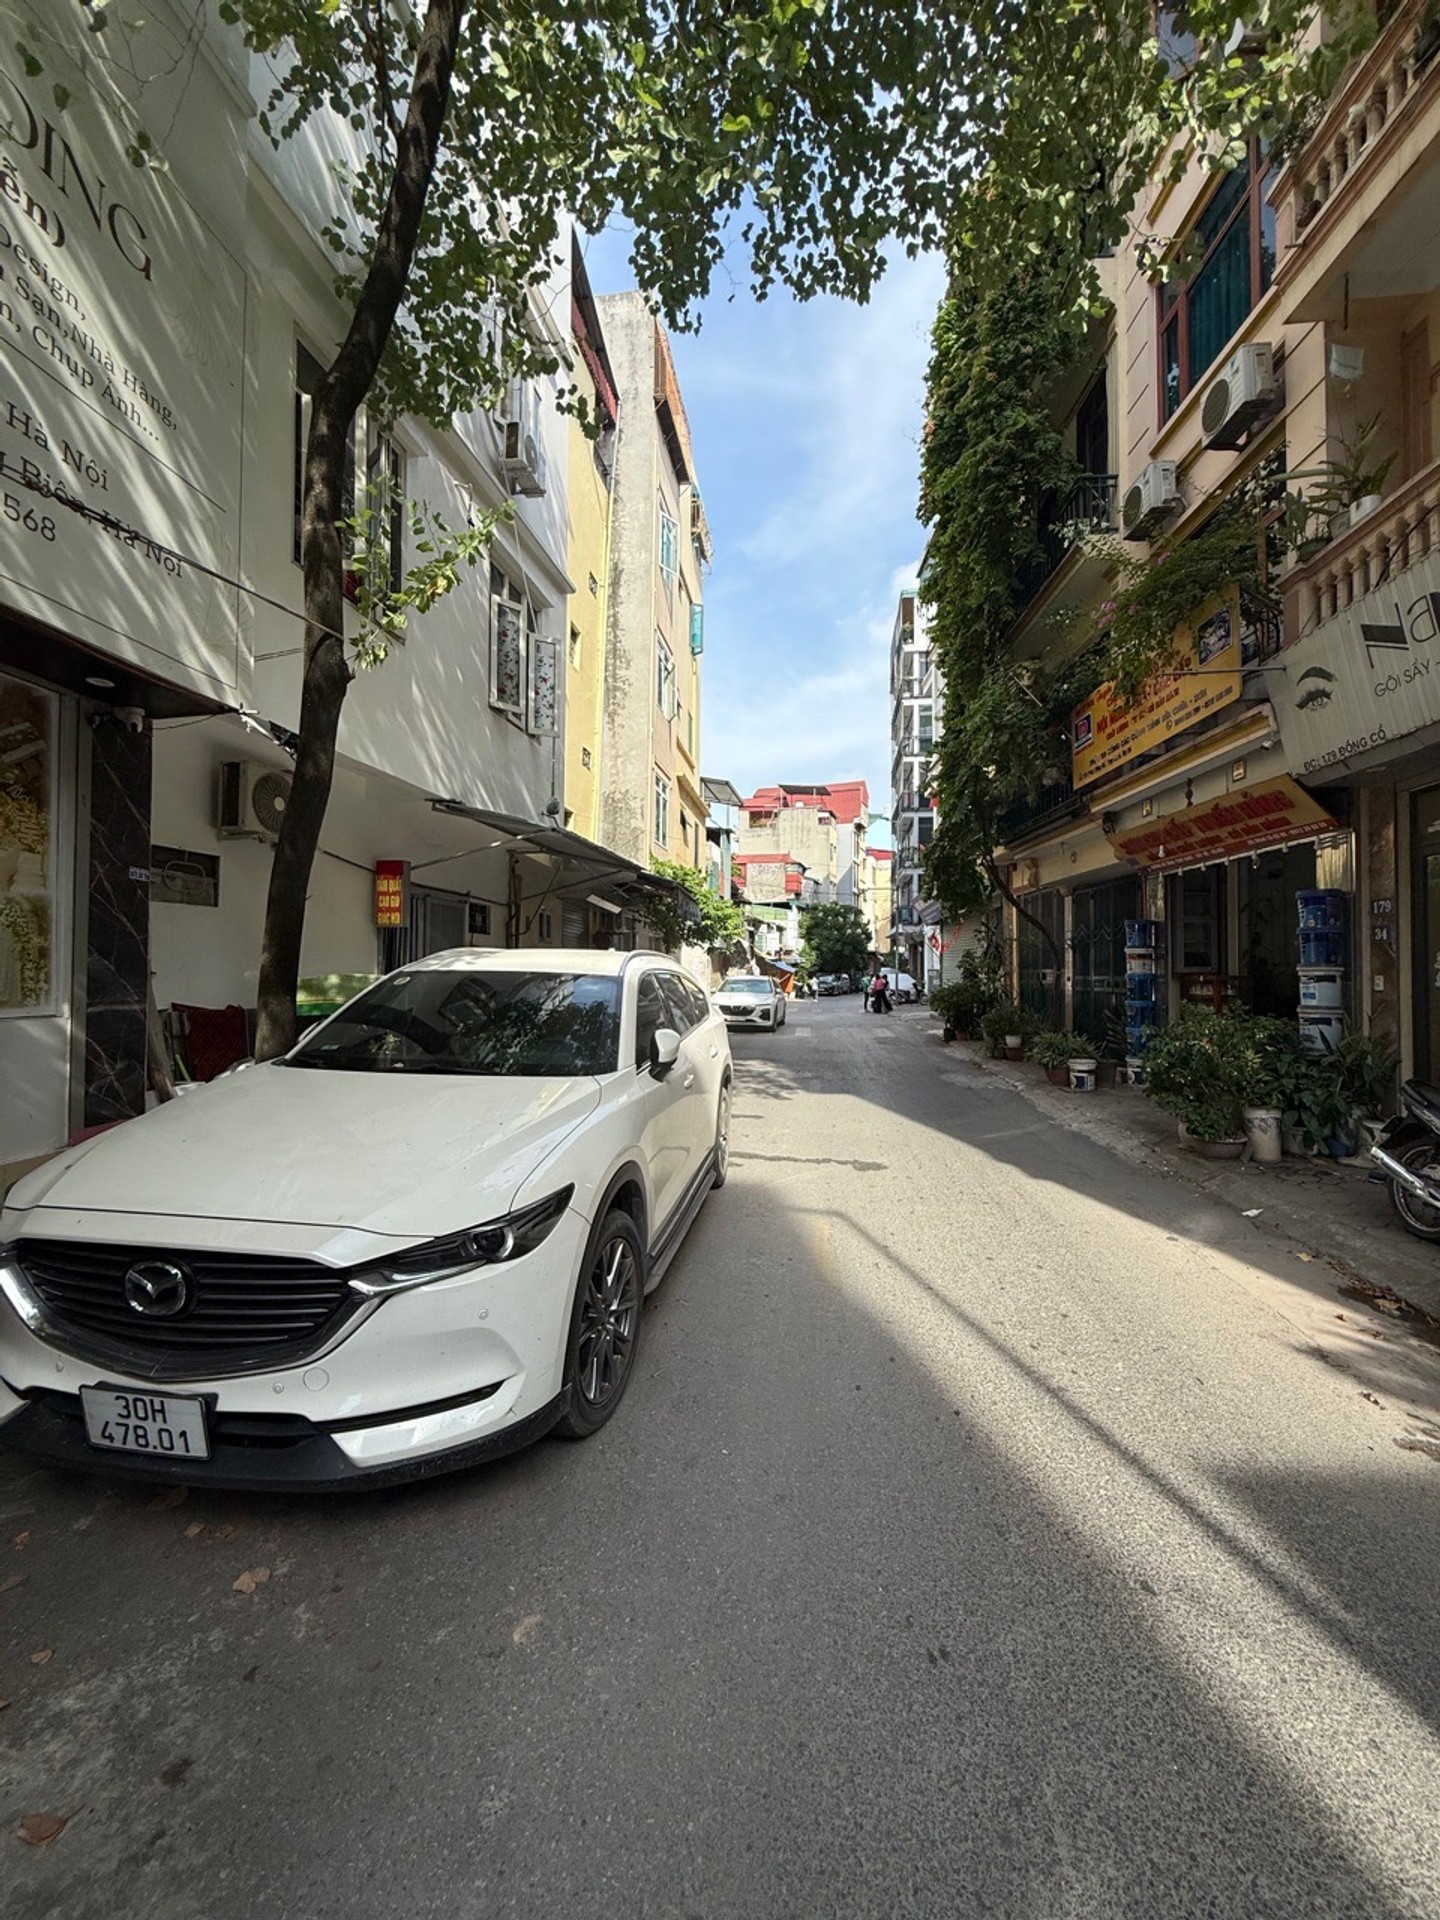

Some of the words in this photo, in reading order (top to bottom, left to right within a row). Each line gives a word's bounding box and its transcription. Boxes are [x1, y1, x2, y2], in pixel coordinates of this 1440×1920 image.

[33, 326, 94, 387] Chụp
[123, 369, 177, 430] Hàng,
[6, 401, 50, 451] Hà
[62, 439, 109, 491] Nội
[3, 493, 56, 542] 568
[1373, 900, 1392, 914] 179
[1374, 928, 1388, 940] 34
[115, 1395, 167, 1424] 30H
[100, 1421, 190, 1453] 478.01
